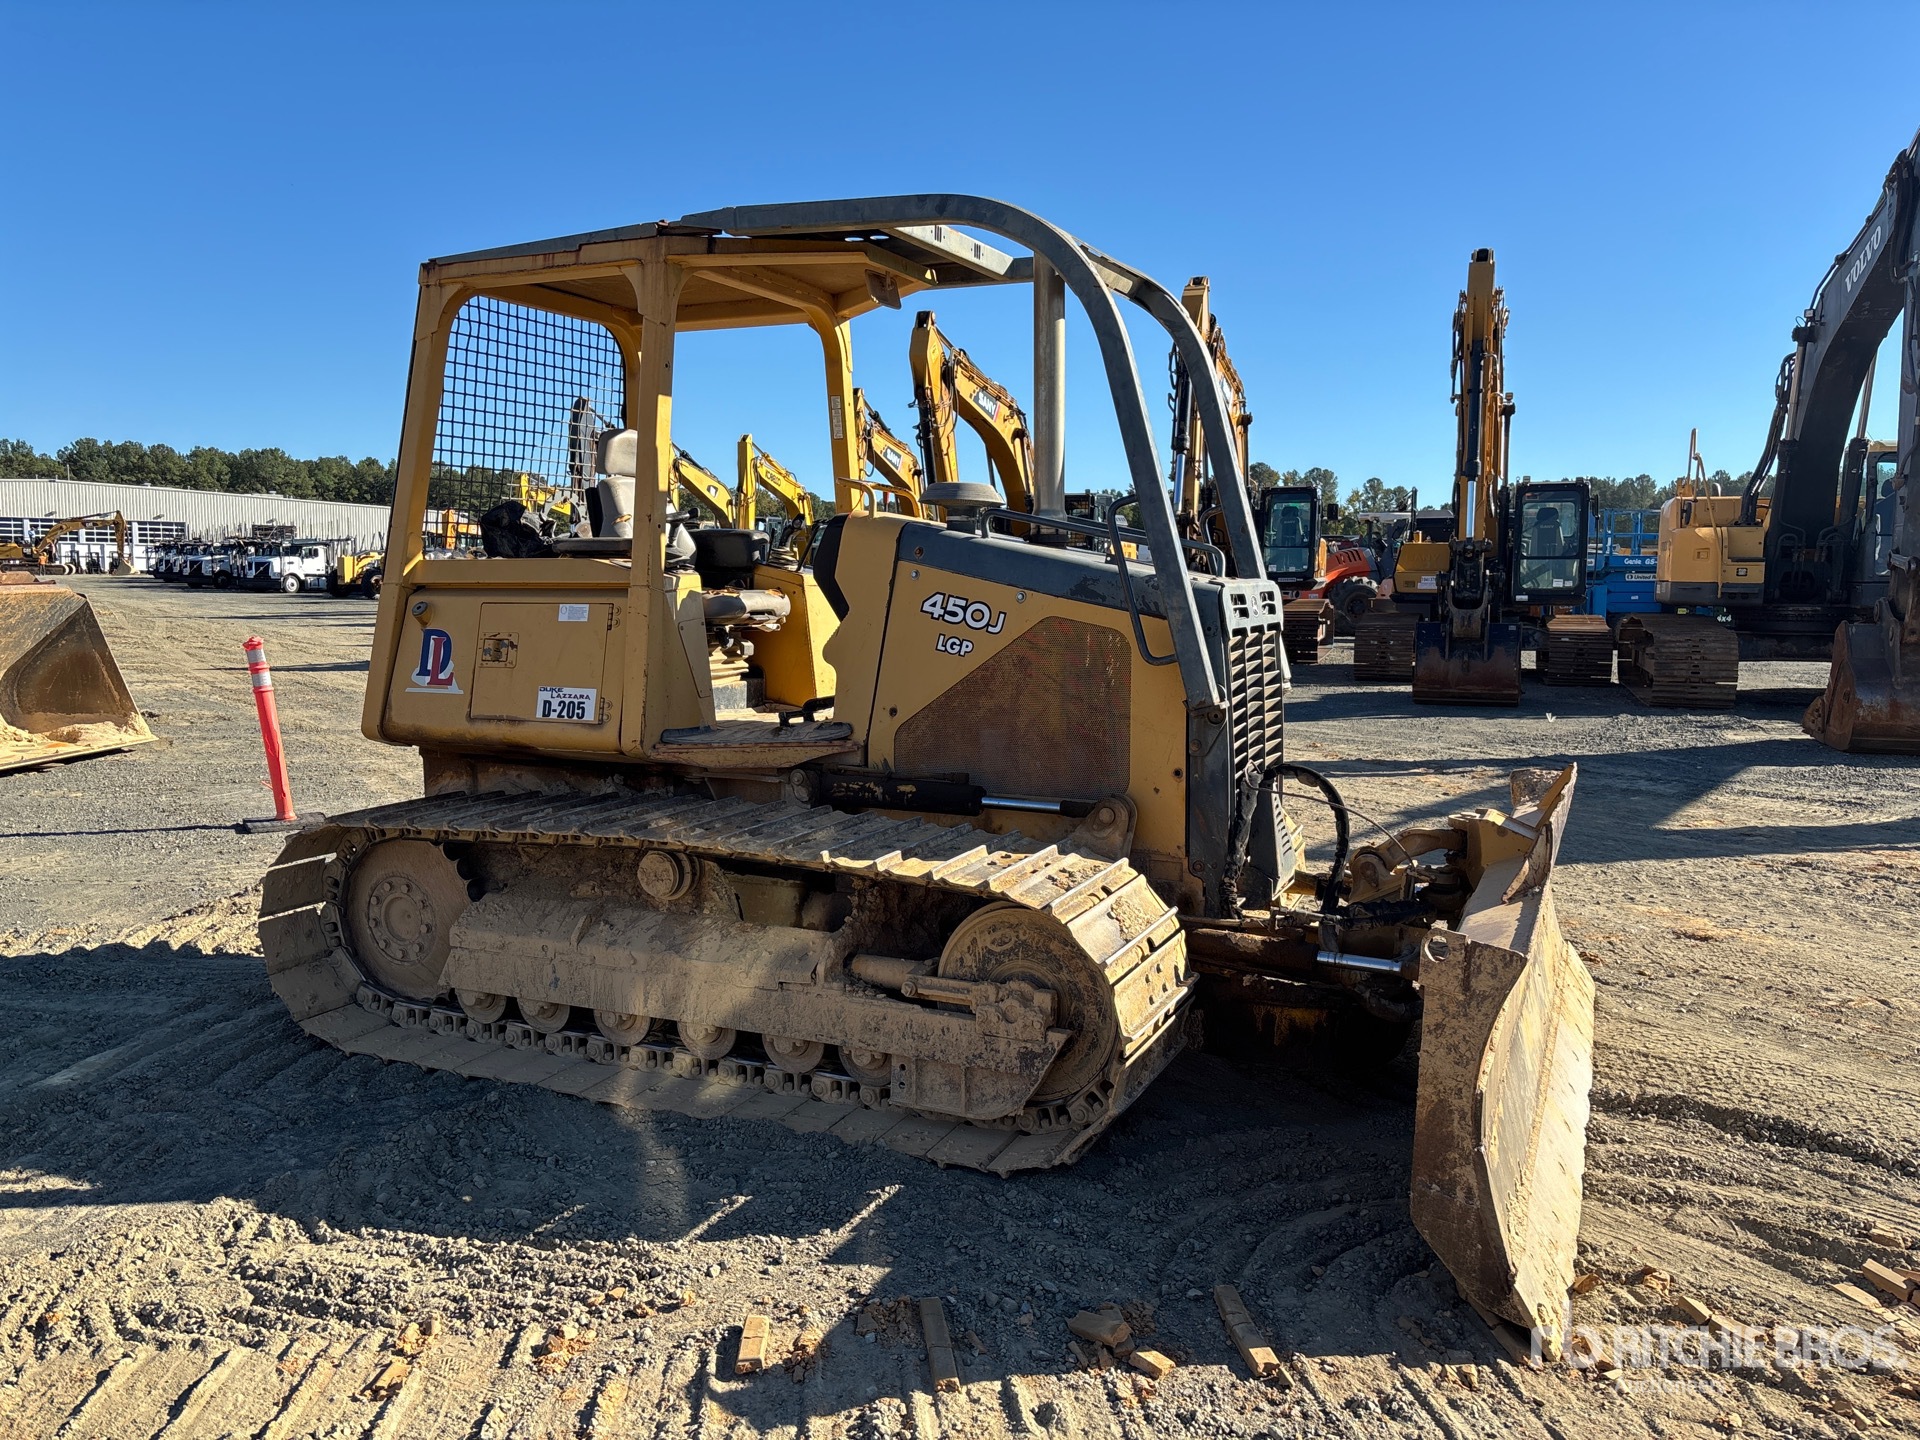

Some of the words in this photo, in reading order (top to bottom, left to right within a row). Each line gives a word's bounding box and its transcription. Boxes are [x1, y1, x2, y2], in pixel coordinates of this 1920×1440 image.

[1845, 226, 1882, 292] VOLVO
[978, 390, 997, 416] SANY
[886, 449, 901, 467] SANY
[920, 591, 1007, 635] 450J
[935, 633, 974, 657] LGP
[539, 686, 565, 694] DUKE
[550, 690, 592, 700] LAZZARA
[542, 699, 586, 720] D-205
